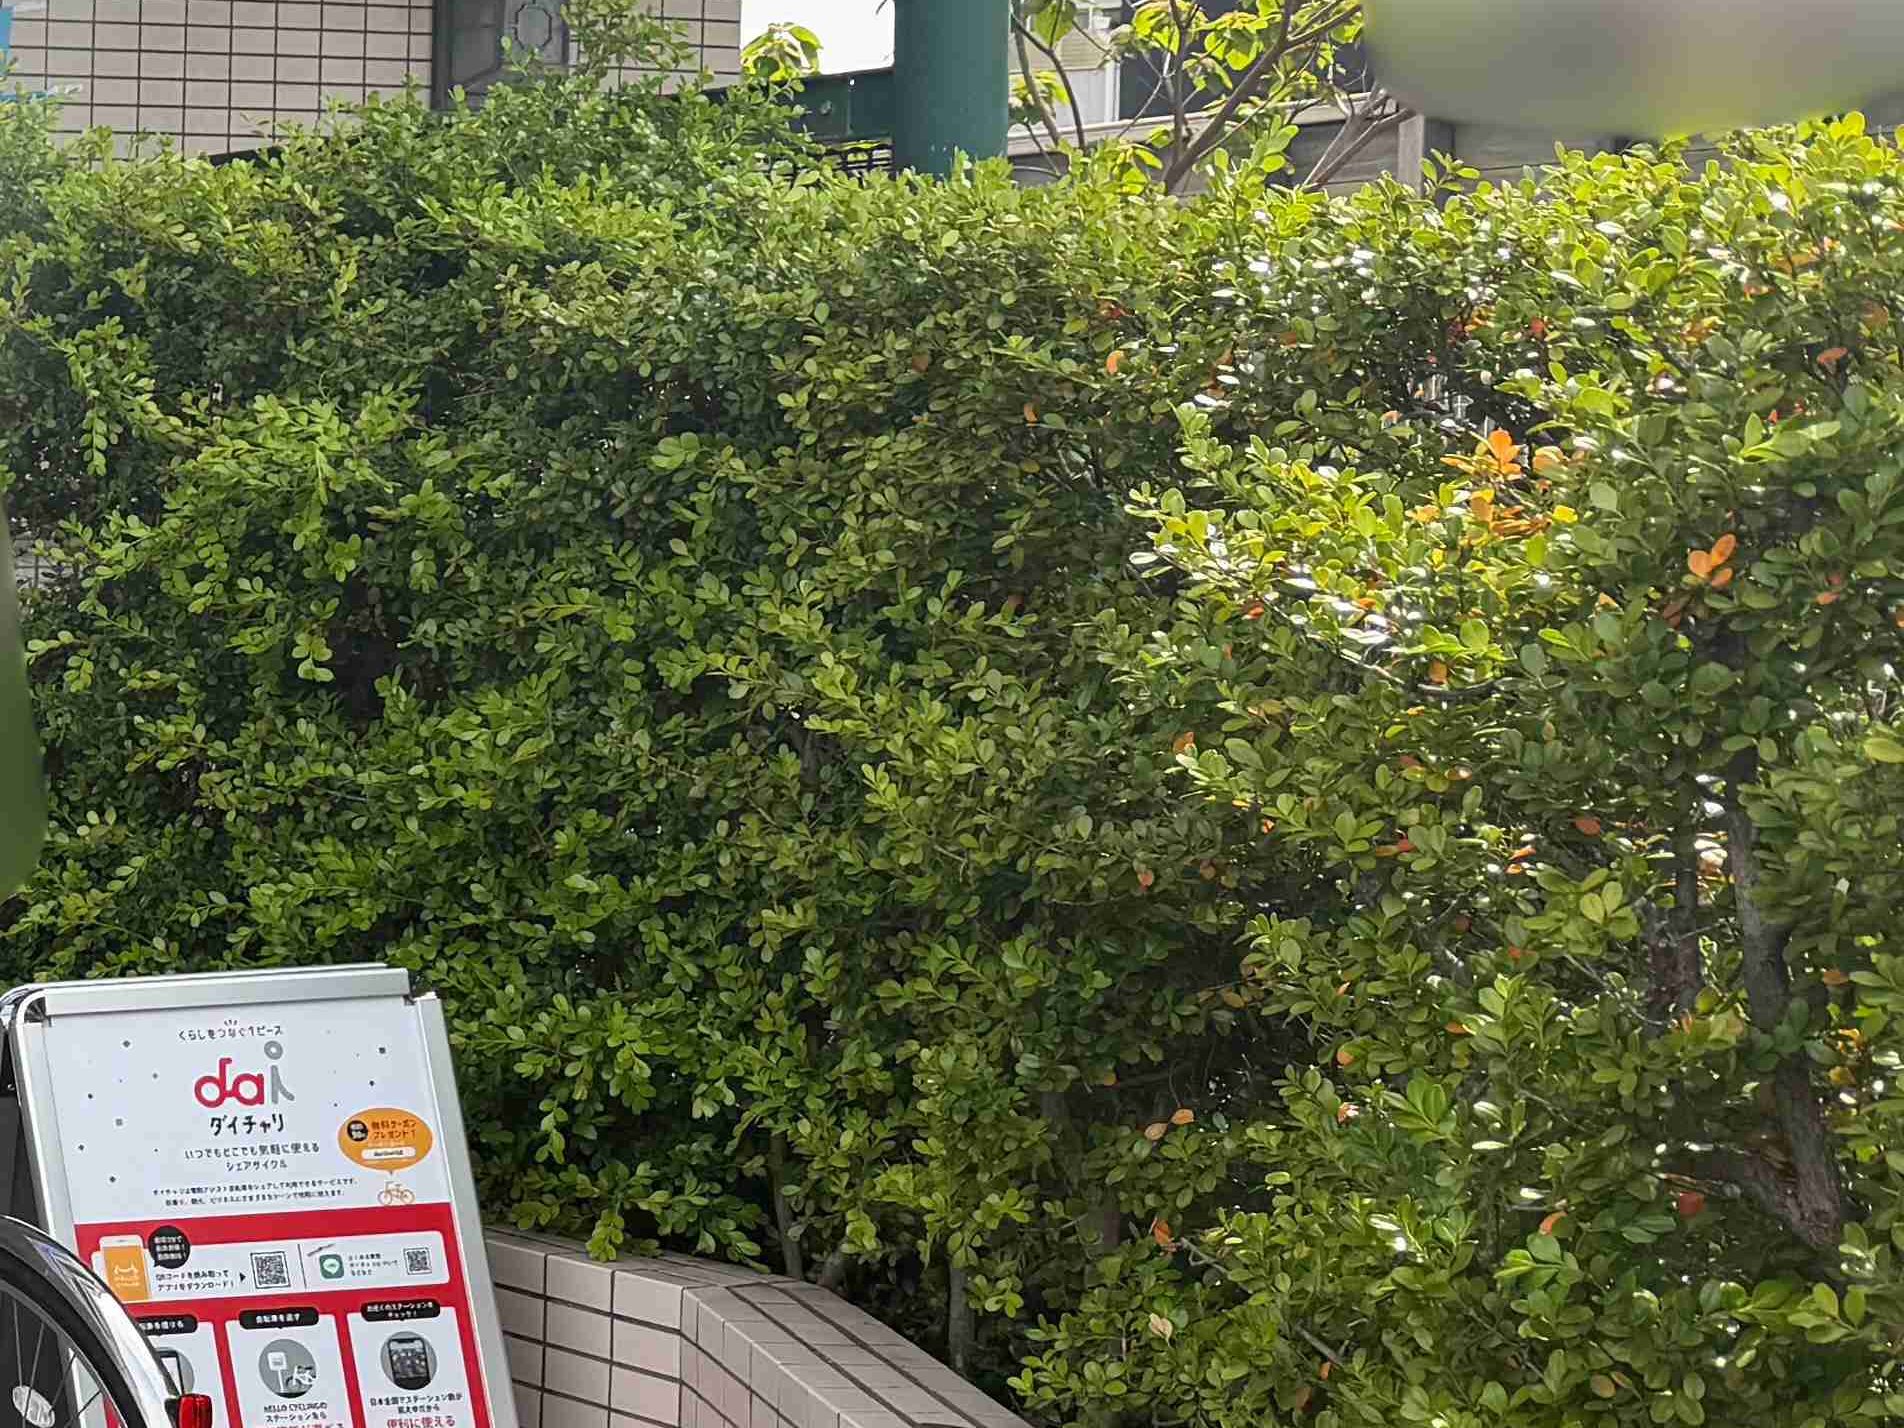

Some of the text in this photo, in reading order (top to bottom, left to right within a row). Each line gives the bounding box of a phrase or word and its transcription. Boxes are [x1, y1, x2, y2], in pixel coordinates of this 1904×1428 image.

[210, 1113, 285, 1137] ダイチャリ
[226, 1159, 288, 1172] シェアサイクル
